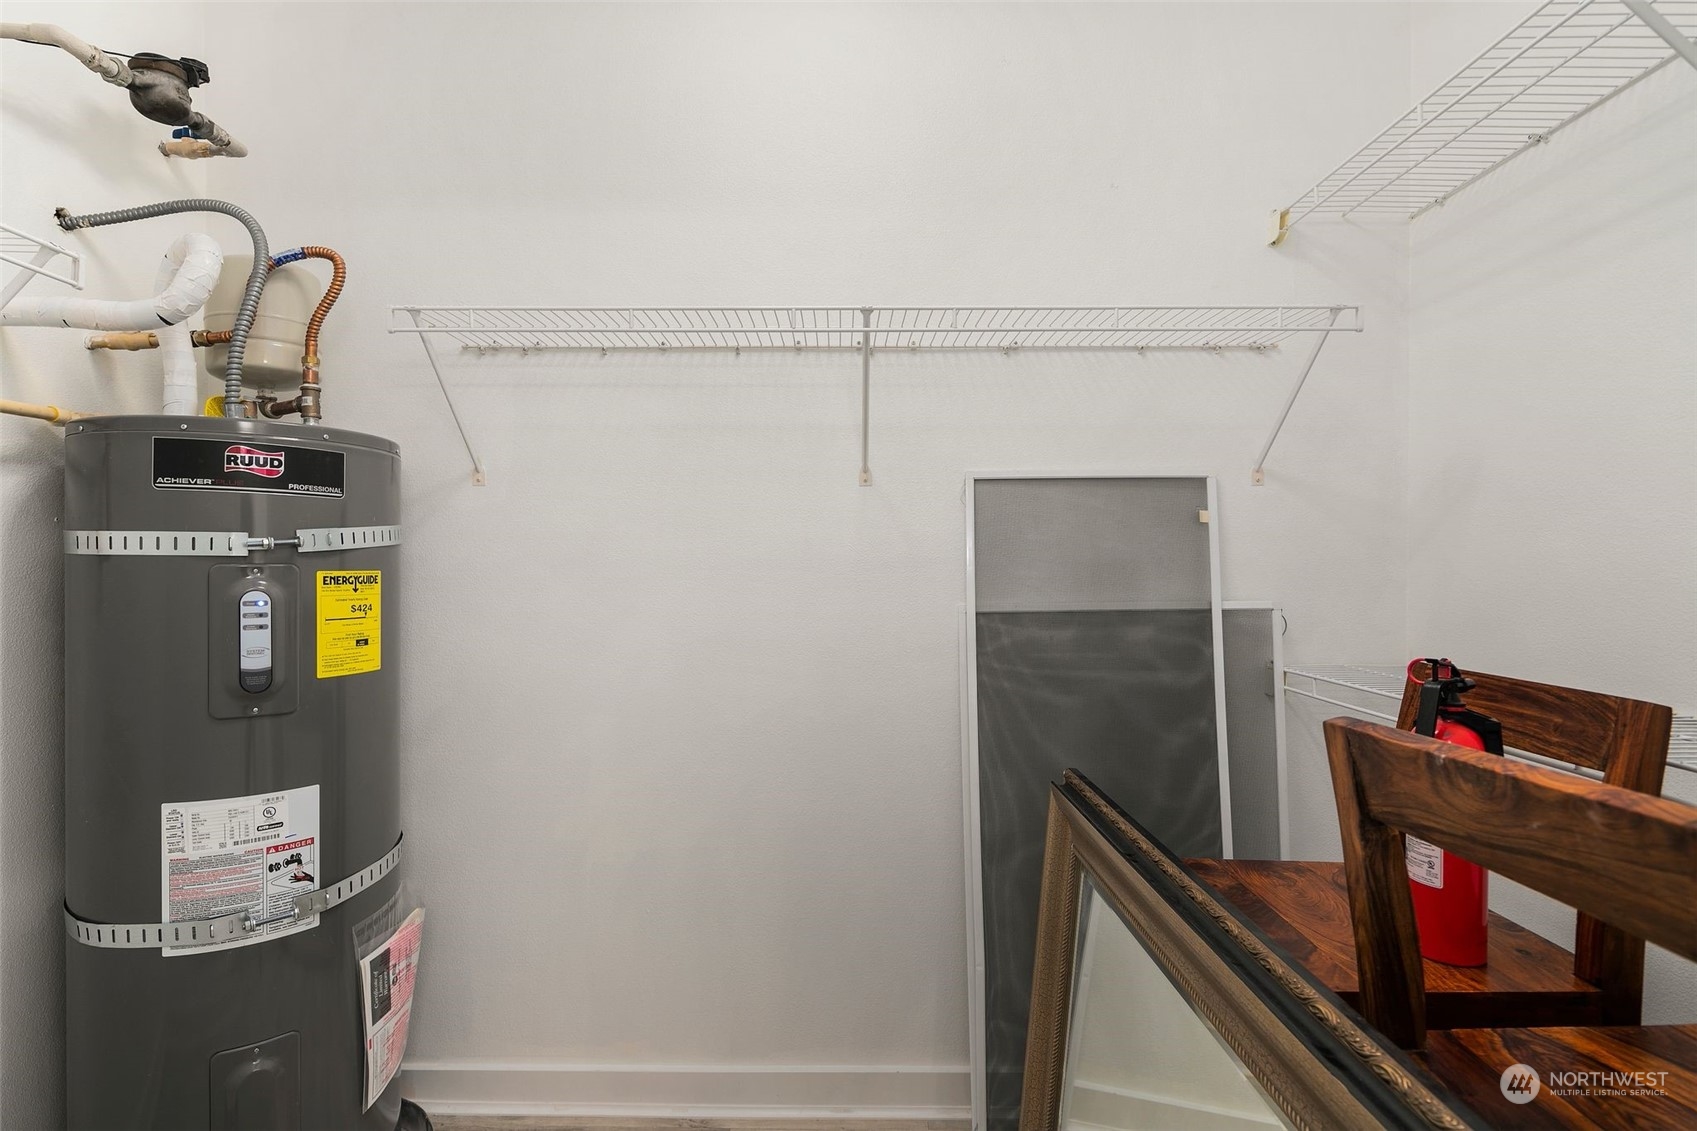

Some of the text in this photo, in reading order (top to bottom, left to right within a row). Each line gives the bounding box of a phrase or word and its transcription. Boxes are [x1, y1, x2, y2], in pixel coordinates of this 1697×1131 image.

[226, 454, 284, 469] RUUD
[288, 483, 342, 494] PROFESSIONAL
[323, 575, 379, 586] ENERGYGUIDE
[277, 839, 312, 851] DANGER
